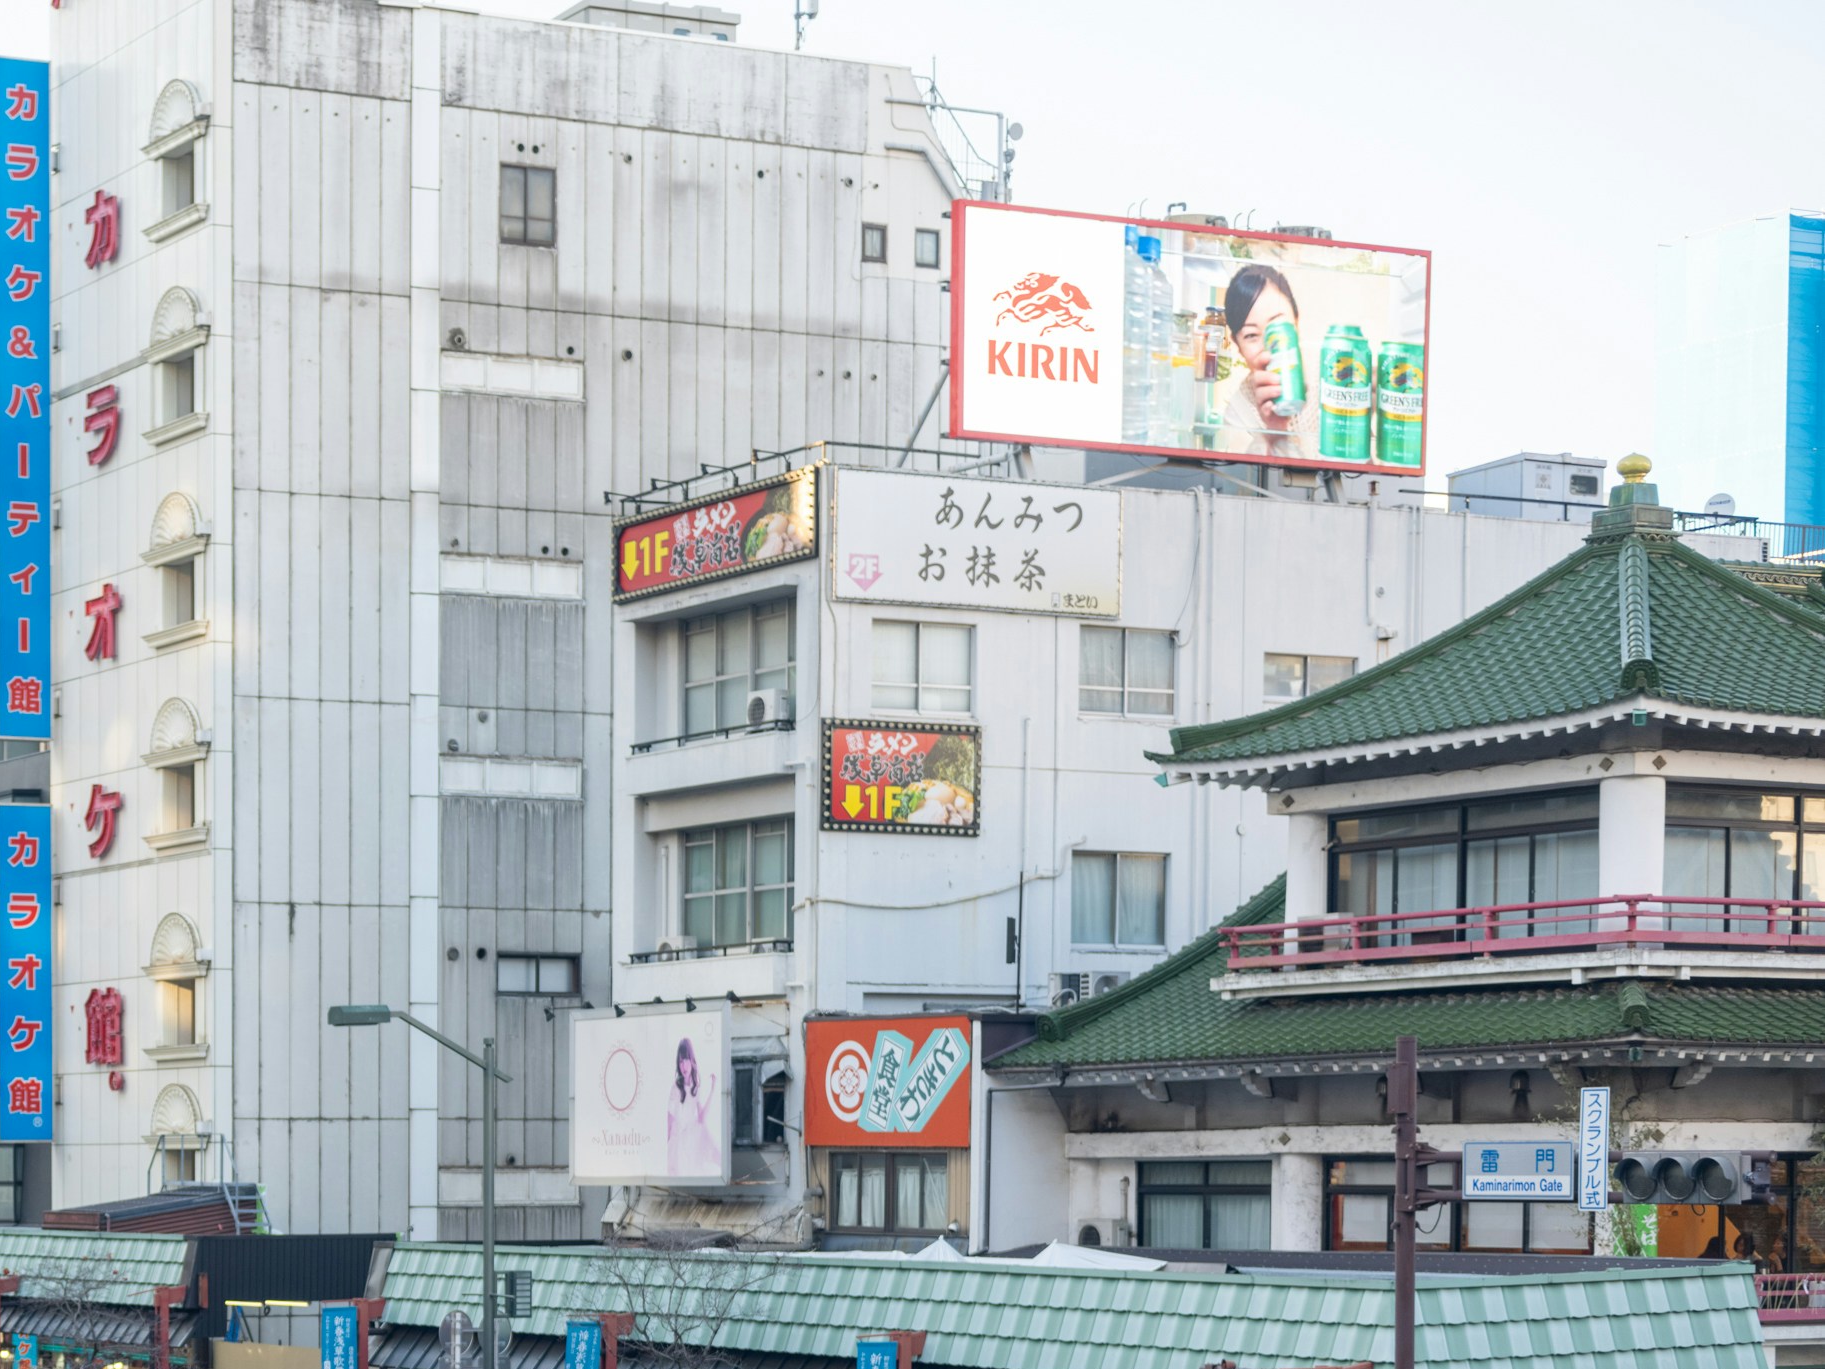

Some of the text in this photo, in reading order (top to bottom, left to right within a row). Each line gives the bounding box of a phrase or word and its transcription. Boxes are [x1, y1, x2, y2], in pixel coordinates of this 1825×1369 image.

[987, 339, 1099, 384] KIRIN
[6, 83, 43, 714] カラオケ&パーティー館
[935, 487, 1083, 533] あんみつ
[639, 531, 670, 577] 1F
[850, 556, 878, 580] 2F
[918, 543, 1046, 592] お抹茶
[84, 189, 122, 1066] カラオケ館
[864, 785, 903, 820] 1F
[8, 831, 43, 1114] カラオケ館
[602, 1127, 641, 1146] Xanadu
[1585, 1093, 1603, 1206] スクランブル式
[1481, 1149, 1554, 1173] 雷門
[1472, 1178, 1563, 1192] Kaminarimon Gate
[1641, 1214, 1656, 1246] そば
